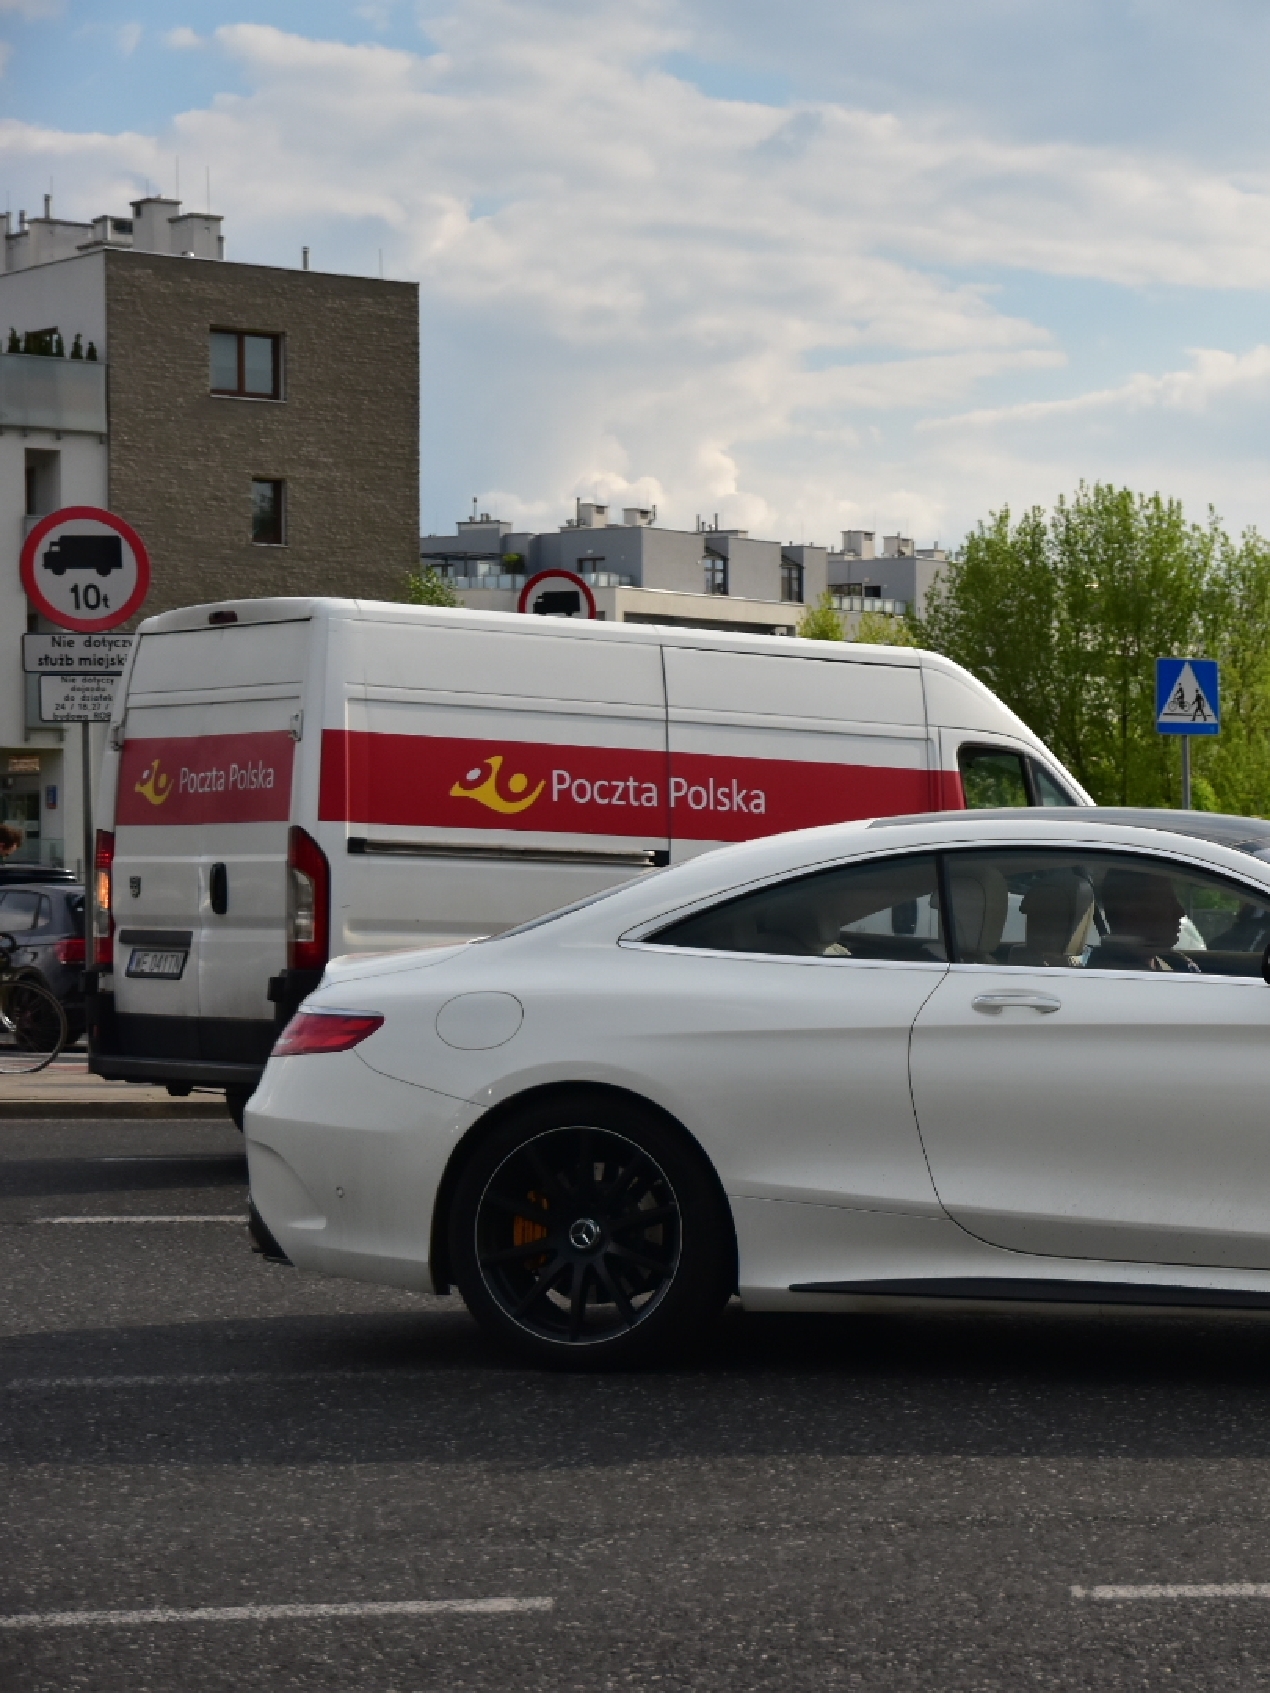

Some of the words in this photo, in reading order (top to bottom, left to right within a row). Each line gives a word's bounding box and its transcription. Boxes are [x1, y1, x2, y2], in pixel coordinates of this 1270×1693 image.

[51, 635, 75, 648] Nie
[38, 654, 75, 667] służb
[179, 766, 225, 794] Poczta
[229, 760, 274, 791] Polska
[552, 769, 658, 807] Poczta
[669, 776, 766, 814] Polska
